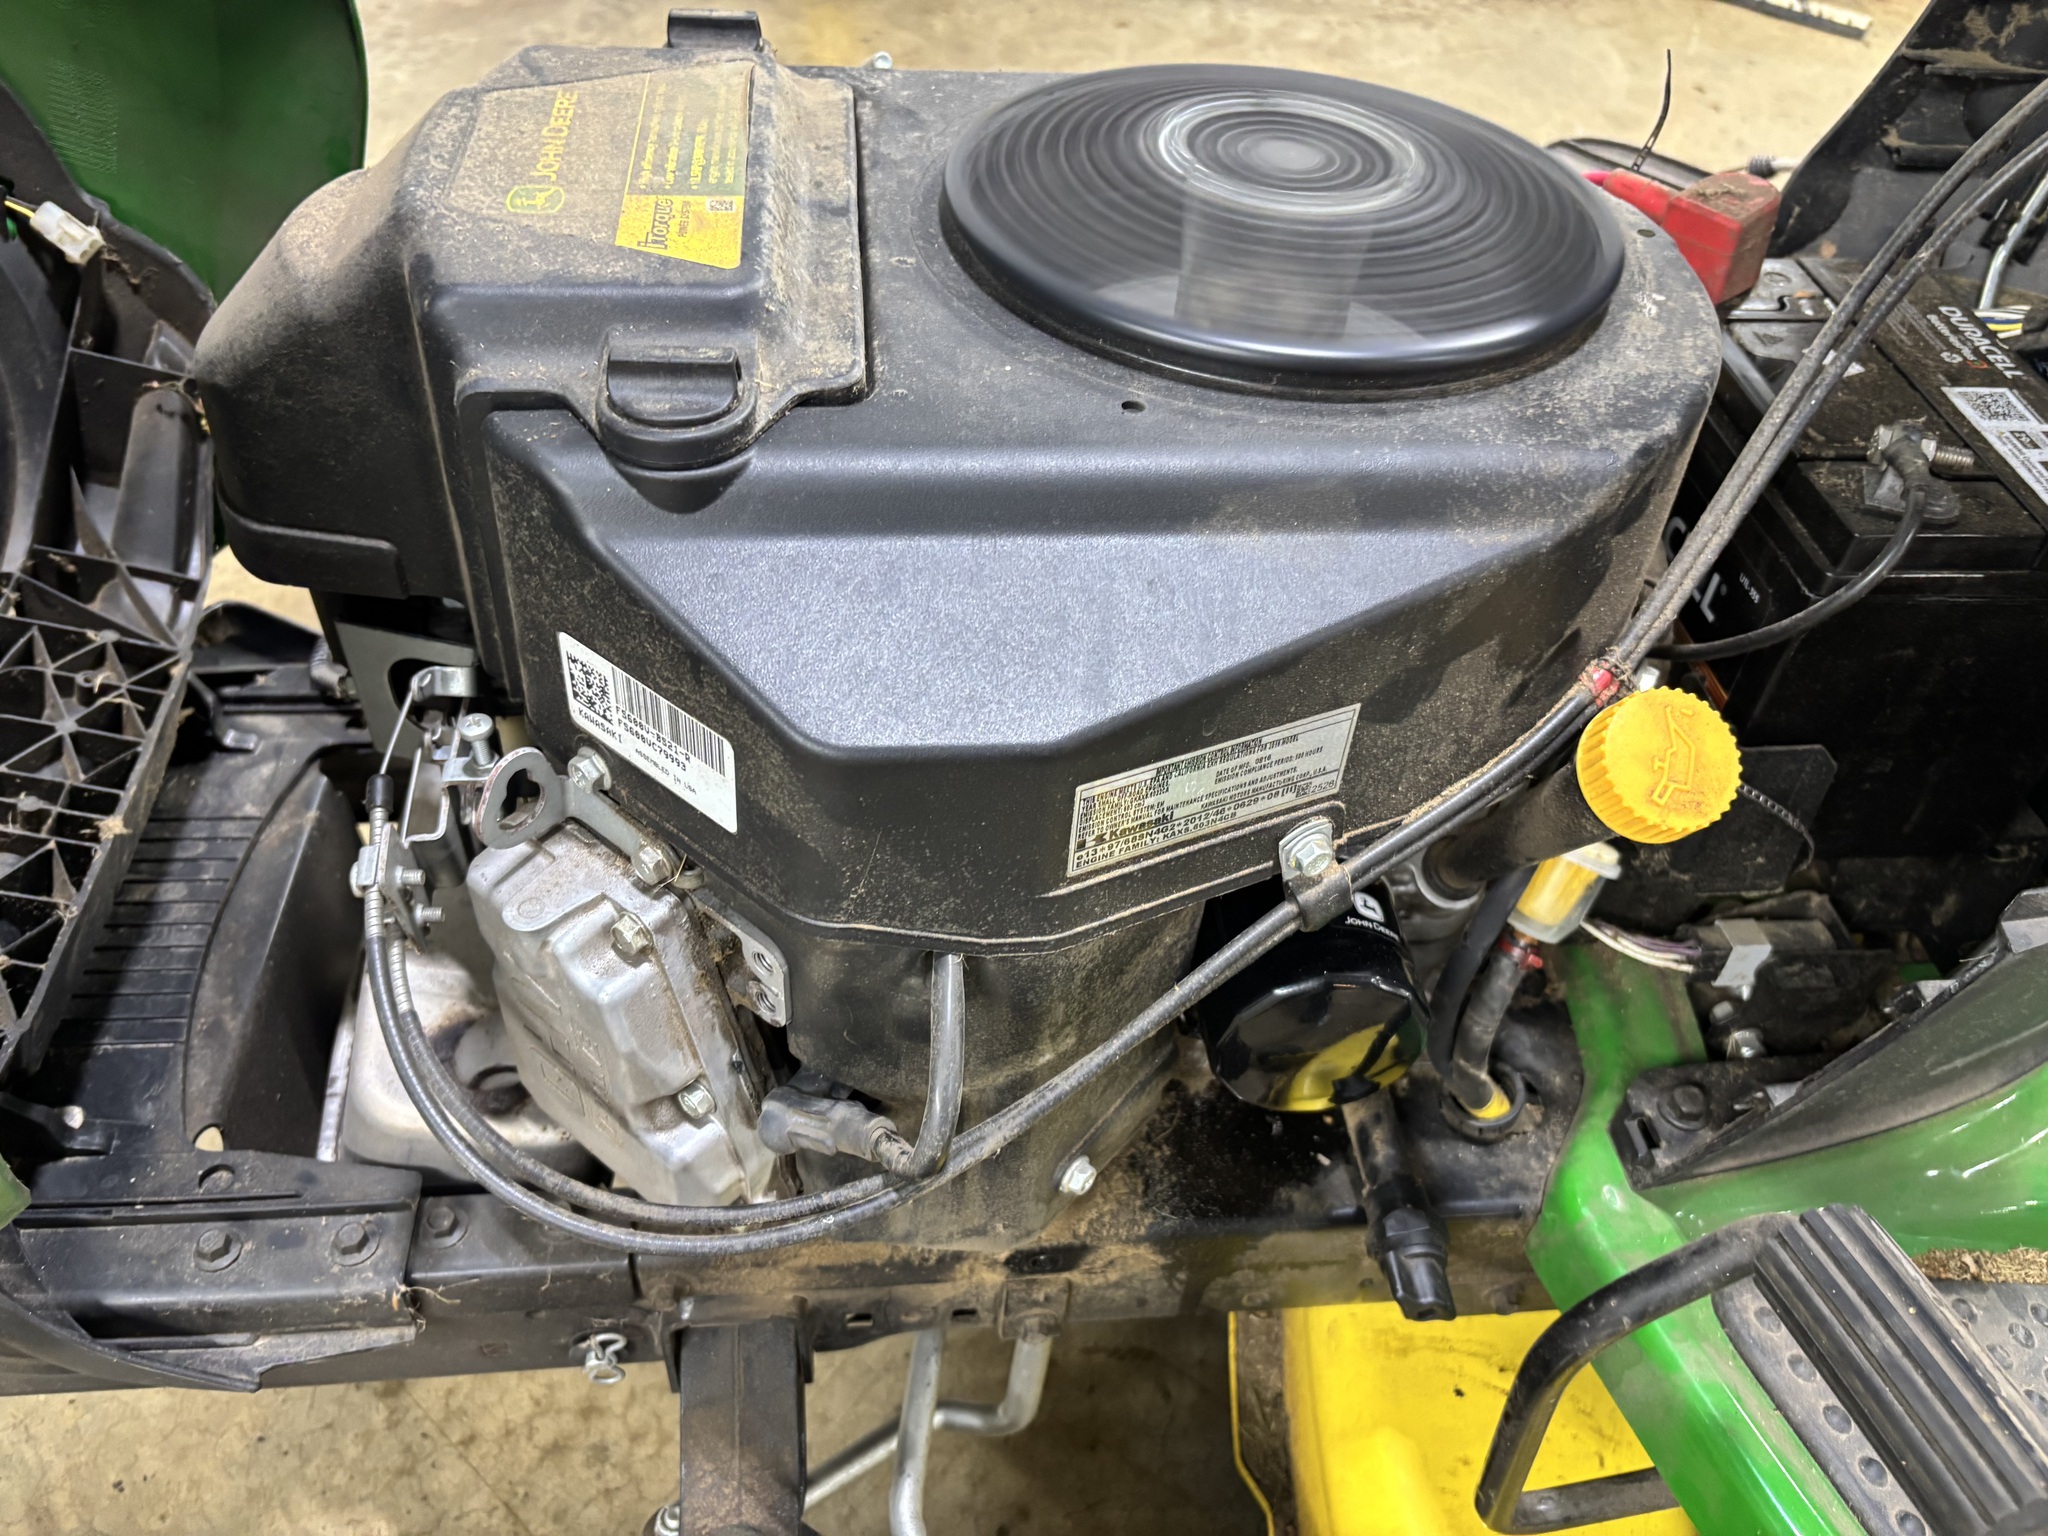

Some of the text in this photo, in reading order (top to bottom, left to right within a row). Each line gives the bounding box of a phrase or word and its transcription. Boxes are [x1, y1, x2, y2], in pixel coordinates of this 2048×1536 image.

[530, 89, 579, 182] JOHN DEERE
[637, 199, 675, 250] iTorque
[1938, 306, 2024, 379] DURACELL
[578, 707, 623, 744] KAWASAKI
[615, 705, 691, 764] FS600V-BS21-R
[617, 718, 687, 772] FS600VC79993
[635, 748, 697, 795] ASSEMBLED IN USA
[1200, 796, 1228, 809] KAWASAKI
[1228, 789, 1250, 801] MOTORS
[1251, 775, 1294, 794] MANUFACTURING
[1310, 779, 1335, 793] 2526
[1078, 819, 1104, 832] EMISSION
[1105, 811, 1131, 824] CONTROL
[1096, 826, 1104, 834] TO
[1154, 807, 1164, 816] FOR
[1165, 795, 1203, 812] MAINTENANCE
[1204, 782, 1246, 800] SPECIFICATIONS
[1247, 778, 1258, 787] AND
[1109, 811, 1173, 839] Kawasaki
[1075, 850, 1115, 867] ENGINE
[1345, 916, 1373, 929] JOHN
